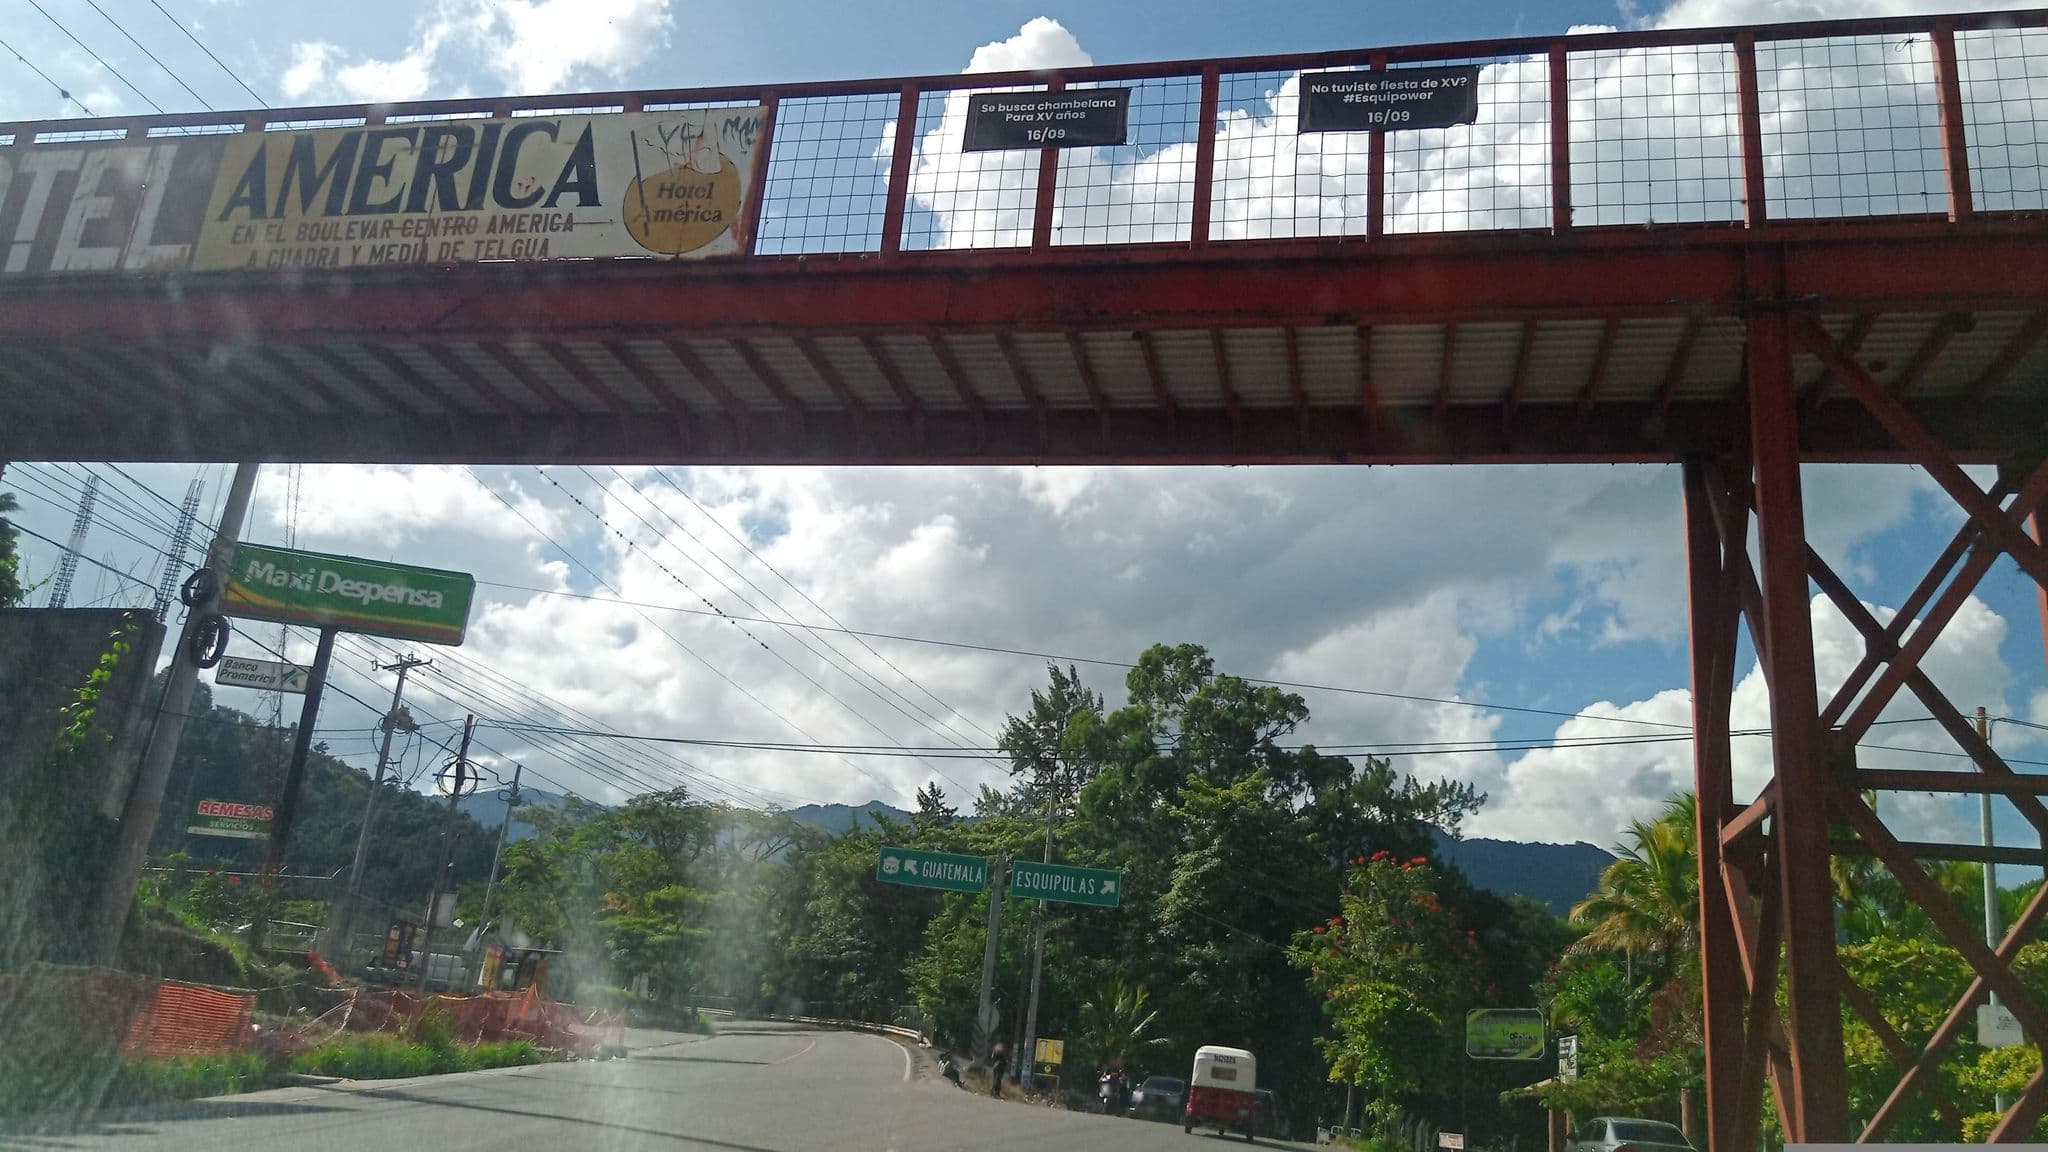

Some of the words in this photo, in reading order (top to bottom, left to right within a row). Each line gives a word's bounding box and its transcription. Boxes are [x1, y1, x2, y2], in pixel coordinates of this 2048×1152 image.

[1311, 84, 1329, 94] No
[1332, 81, 1377, 93] tuviste
[1381, 79, 1418, 91] fiesta
[1421, 79, 1438, 89] de
[1441, 76, 1467, 88] XV?
[981, 103, 996, 113] Se
[998, 102, 1035, 112] busca
[1037, 98, 1117, 111] chambelana
[1343, 90, 1433, 105] #Esquipower
[1005, 112, 1034, 122] Para
[1036, 111, 1053, 121] XV
[1055, 109, 1086, 120] años
[1367, 109, 1410, 124] 16/09
[1027, 127, 1066, 143] 16/09
[0, 144, 193, 275] TEL
[216, 120, 603, 222] AMERICA
[657, 181, 715, 199] Hotel
[231, 224, 257, 244] EN
[265, 223, 287, 242] EL
[296, 219, 392, 242] BOULEVAR
[401, 216, 478, 238] CENTRO
[486, 212, 574, 234] AMERICA
[266, 247, 340, 269] CUADRA
[352, 244, 362, 265] Y
[369, 242, 428, 265] MEDIA
[438, 241, 464, 261] DE
[474, 238, 550, 260] TELGUA
[244, 559, 316, 592] Maxi
[318, 568, 445, 608] Despensa
[224, 659, 258, 672] Banco
[220, 669, 277, 684] Promerica
[199, 801, 273, 820] REMESAS
[922, 860, 982, 883] GUATEMALA
[1016, 871, 1095, 895] ESQUIPULAS
